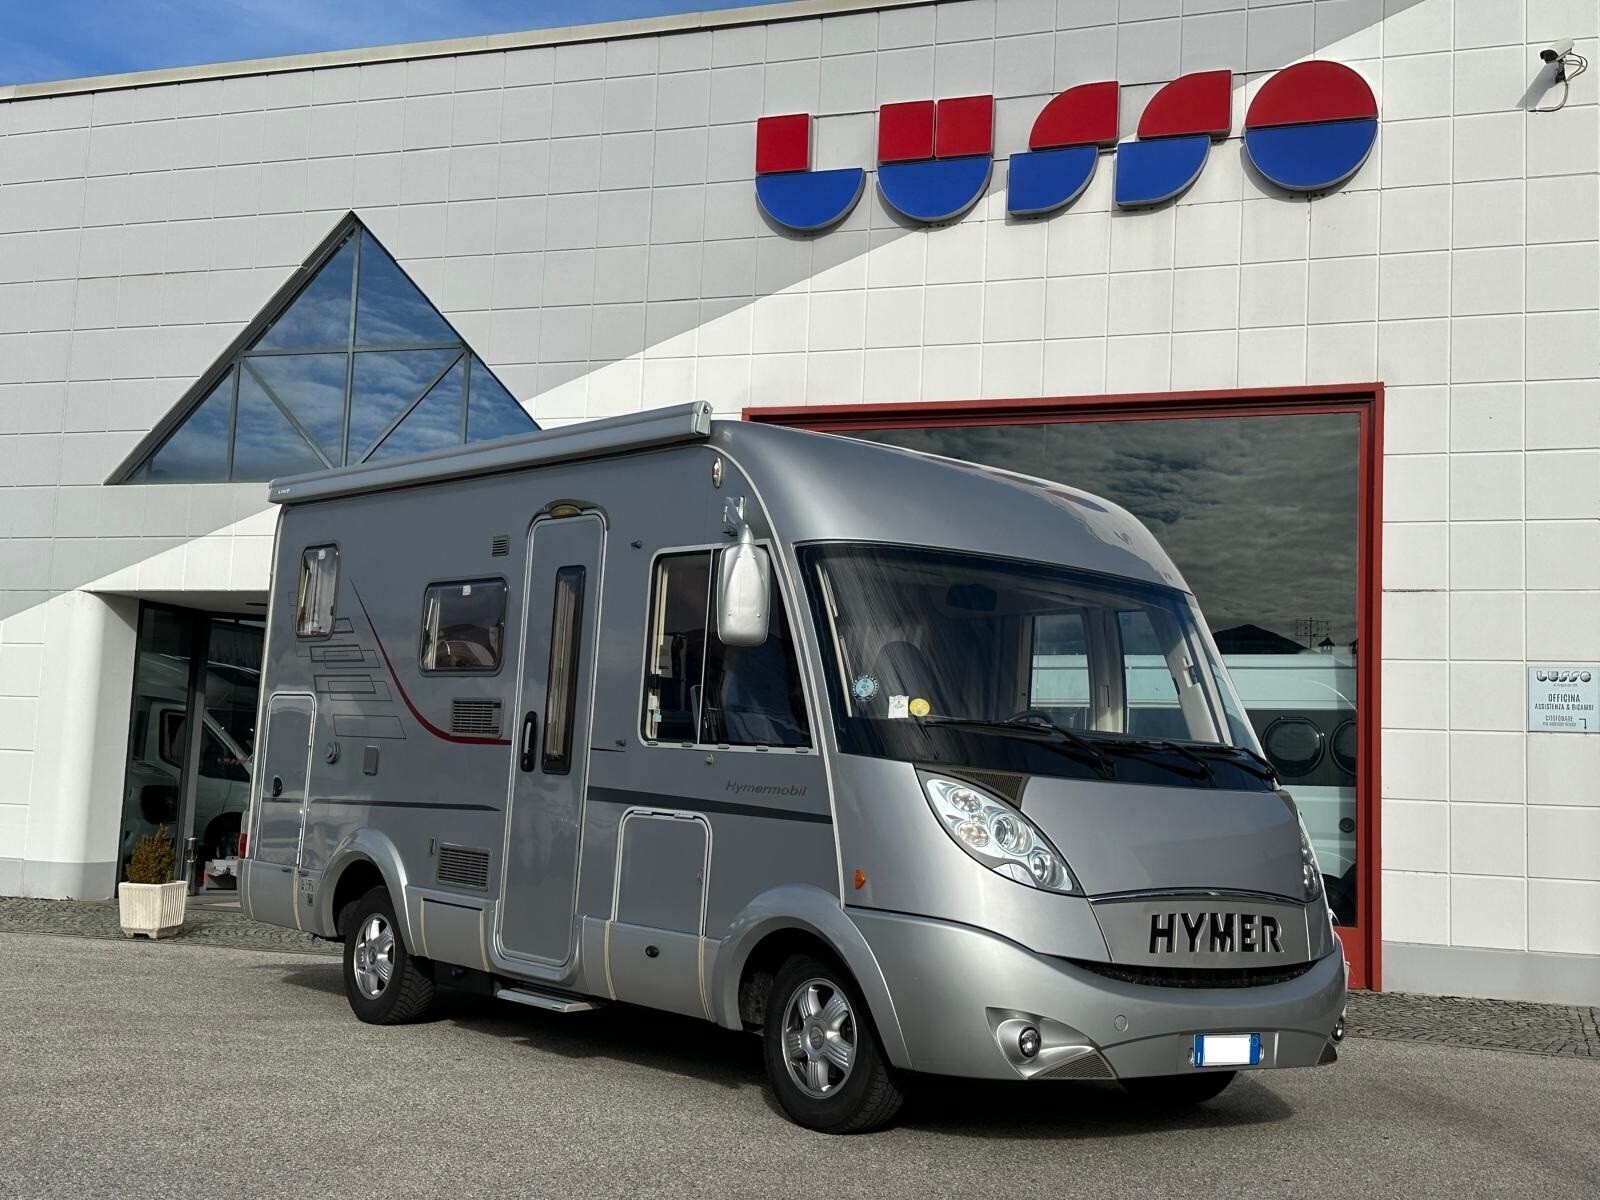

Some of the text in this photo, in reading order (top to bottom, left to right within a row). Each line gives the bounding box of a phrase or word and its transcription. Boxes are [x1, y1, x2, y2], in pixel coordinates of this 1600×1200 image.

[755, 60, 1379, 232] LUSSO
[1536, 670, 1592, 683] LUSSO
[1548, 693, 1580, 703] OFFICINA
[725, 780, 808, 797] Hymermobil
[1149, 912, 1284, 954] HYMER
